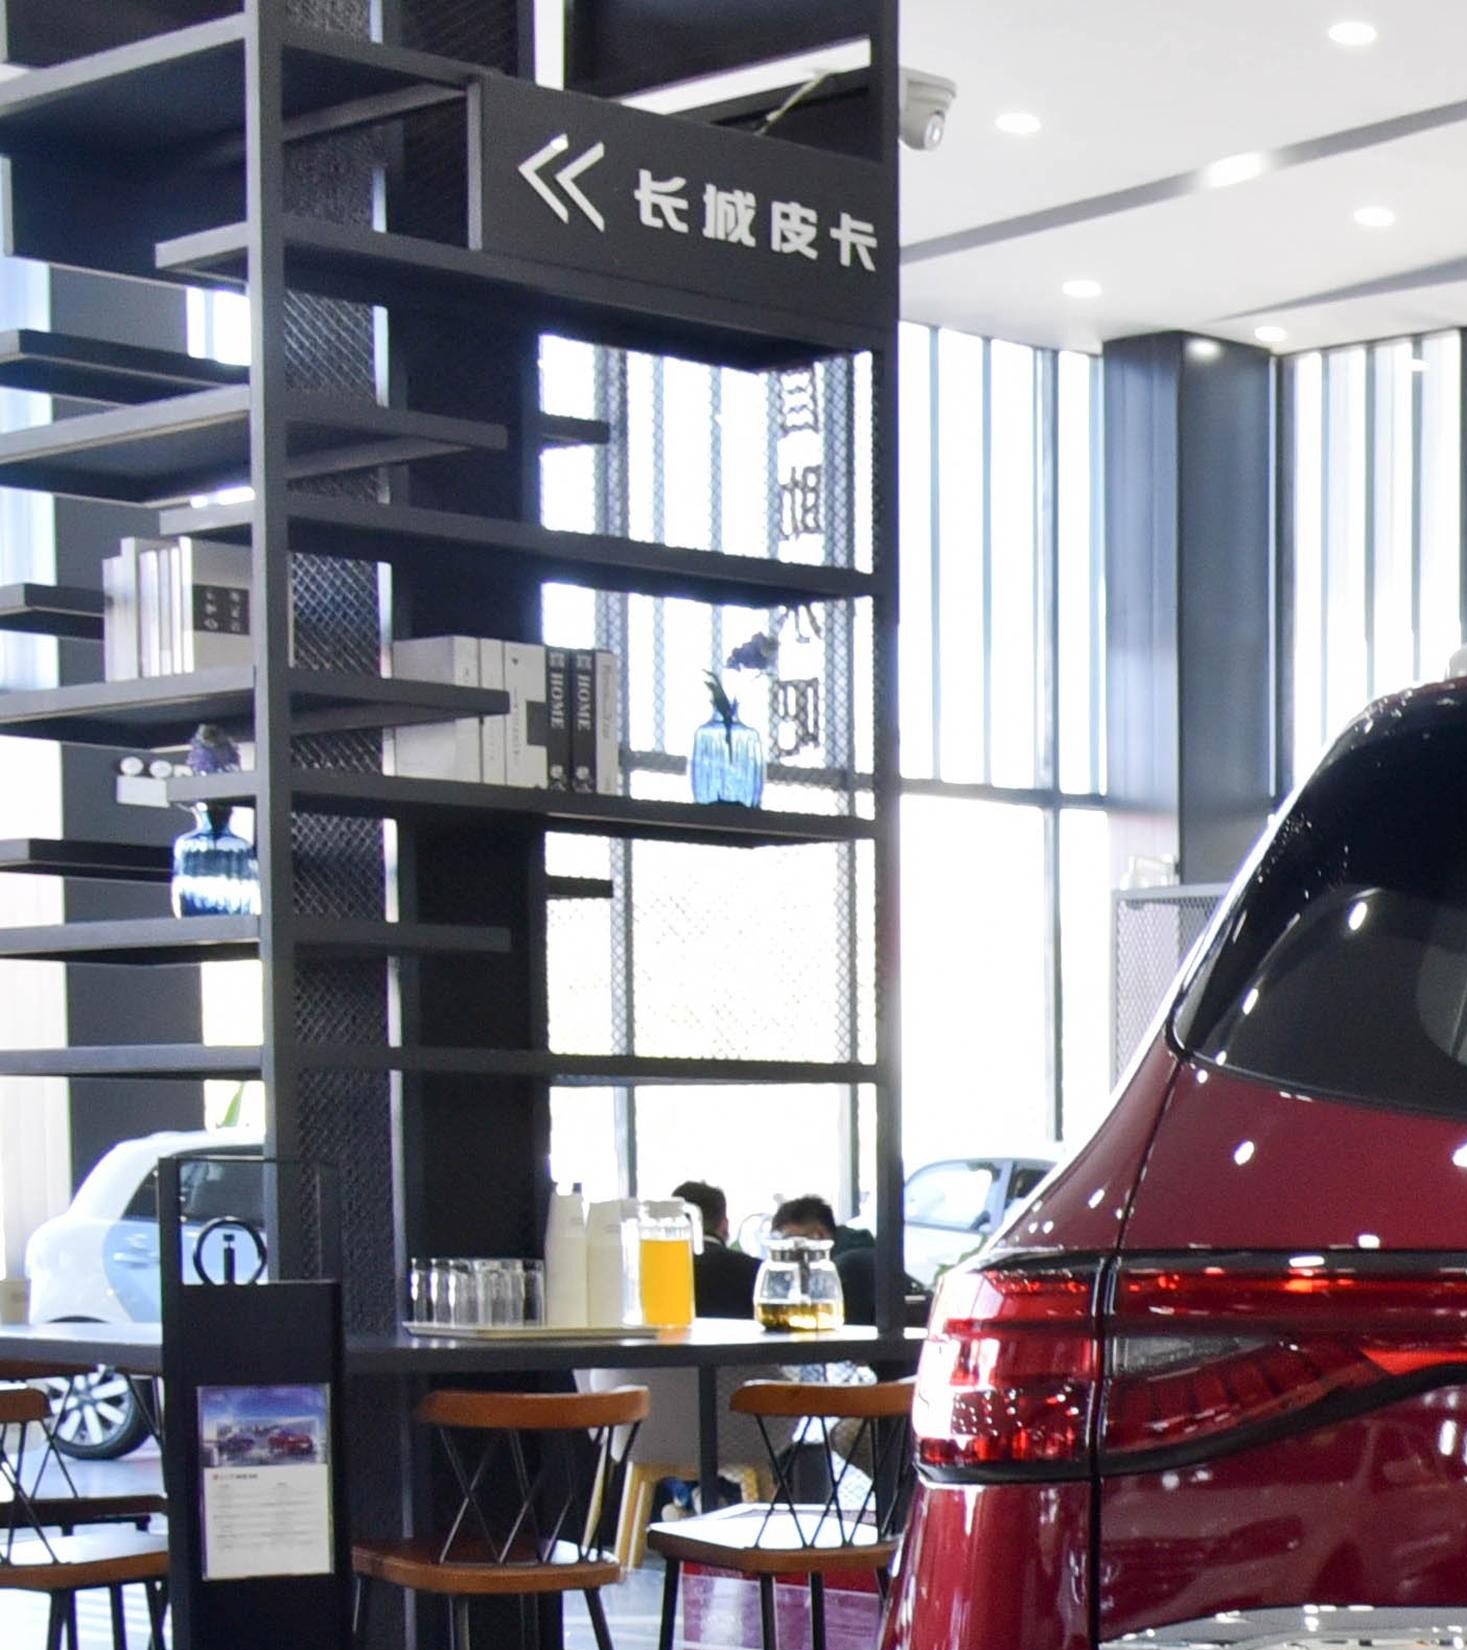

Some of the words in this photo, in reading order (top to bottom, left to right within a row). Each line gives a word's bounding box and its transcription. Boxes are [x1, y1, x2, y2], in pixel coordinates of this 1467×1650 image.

[633, 167, 878, 272] 长城皮卡
[551, 672, 565, 729] HOME
[577, 674, 591, 731] HOME
